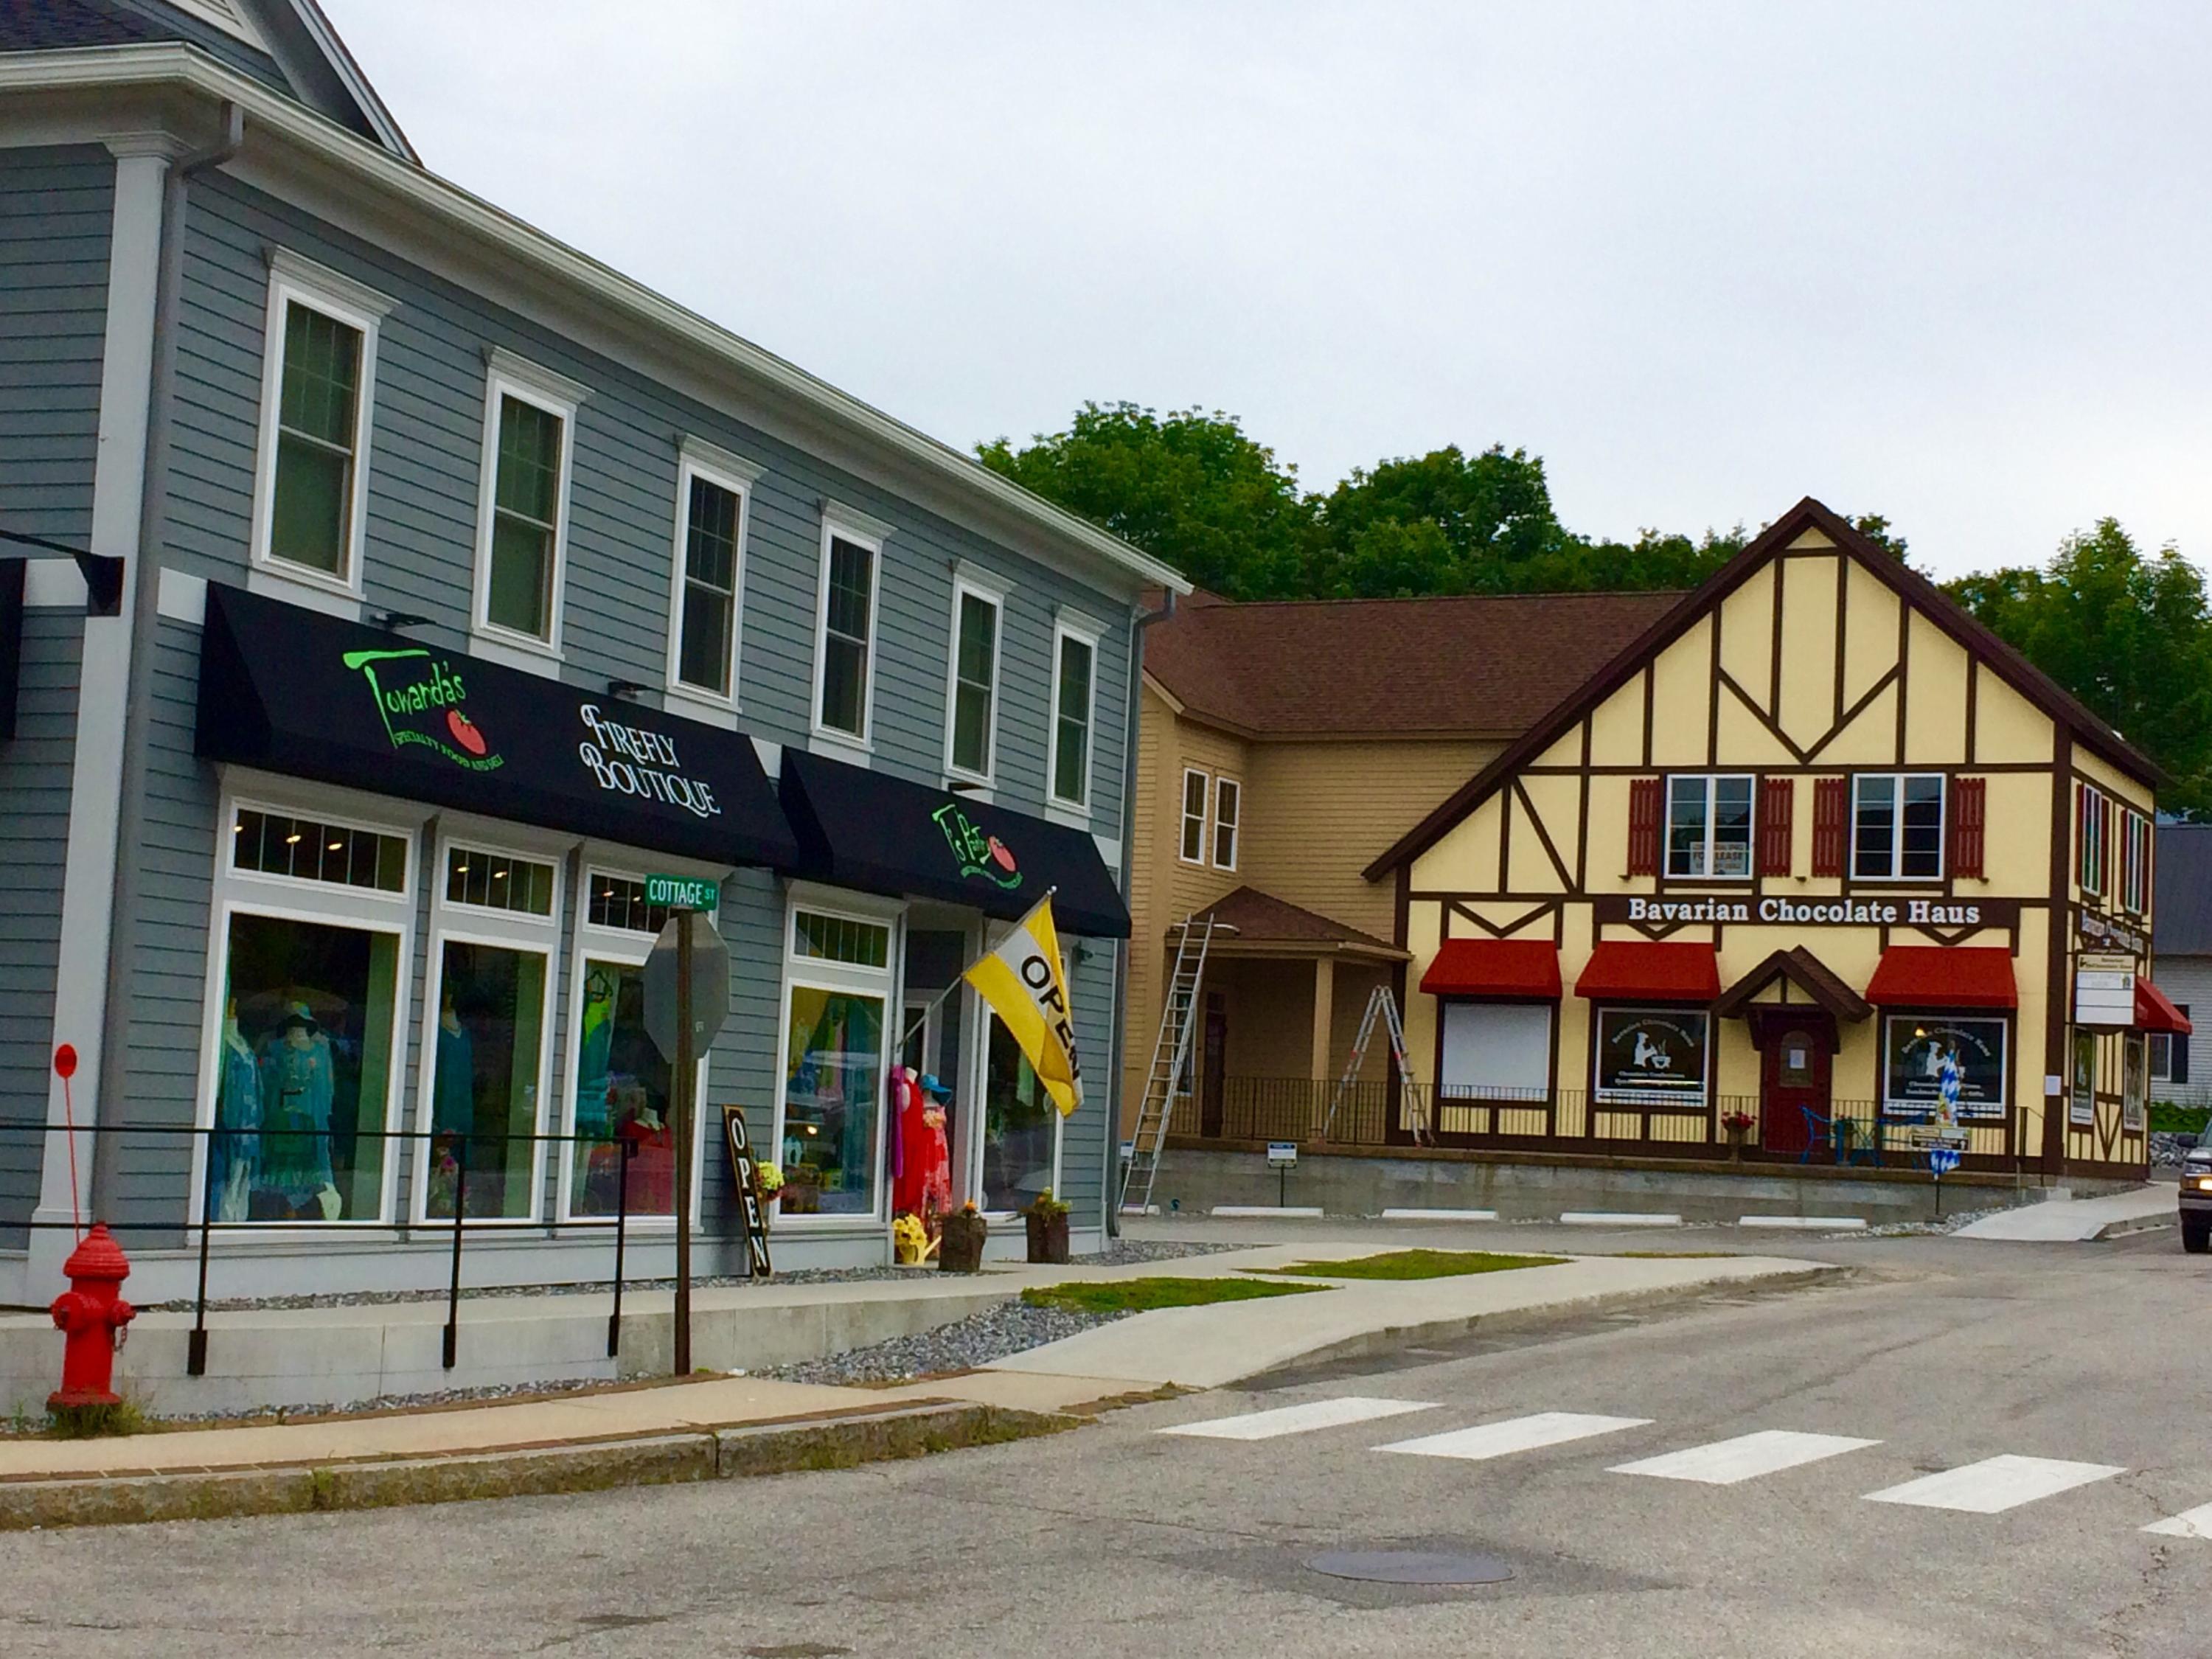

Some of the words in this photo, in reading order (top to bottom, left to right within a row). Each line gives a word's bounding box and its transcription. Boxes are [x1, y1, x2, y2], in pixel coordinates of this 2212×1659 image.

[580, 704, 681, 768] FIREFLY
[580, 742, 721, 818] BOUTIQUE
[650, 879, 703, 905] COTTAGE
[704, 888, 715, 900] ST
[1628, 897, 1749, 921] Bavarian
[1759, 899, 1897, 922] Chocolate
[1907, 900, 1980, 923] Haus
[731, 1117, 768, 1268] OPEN
